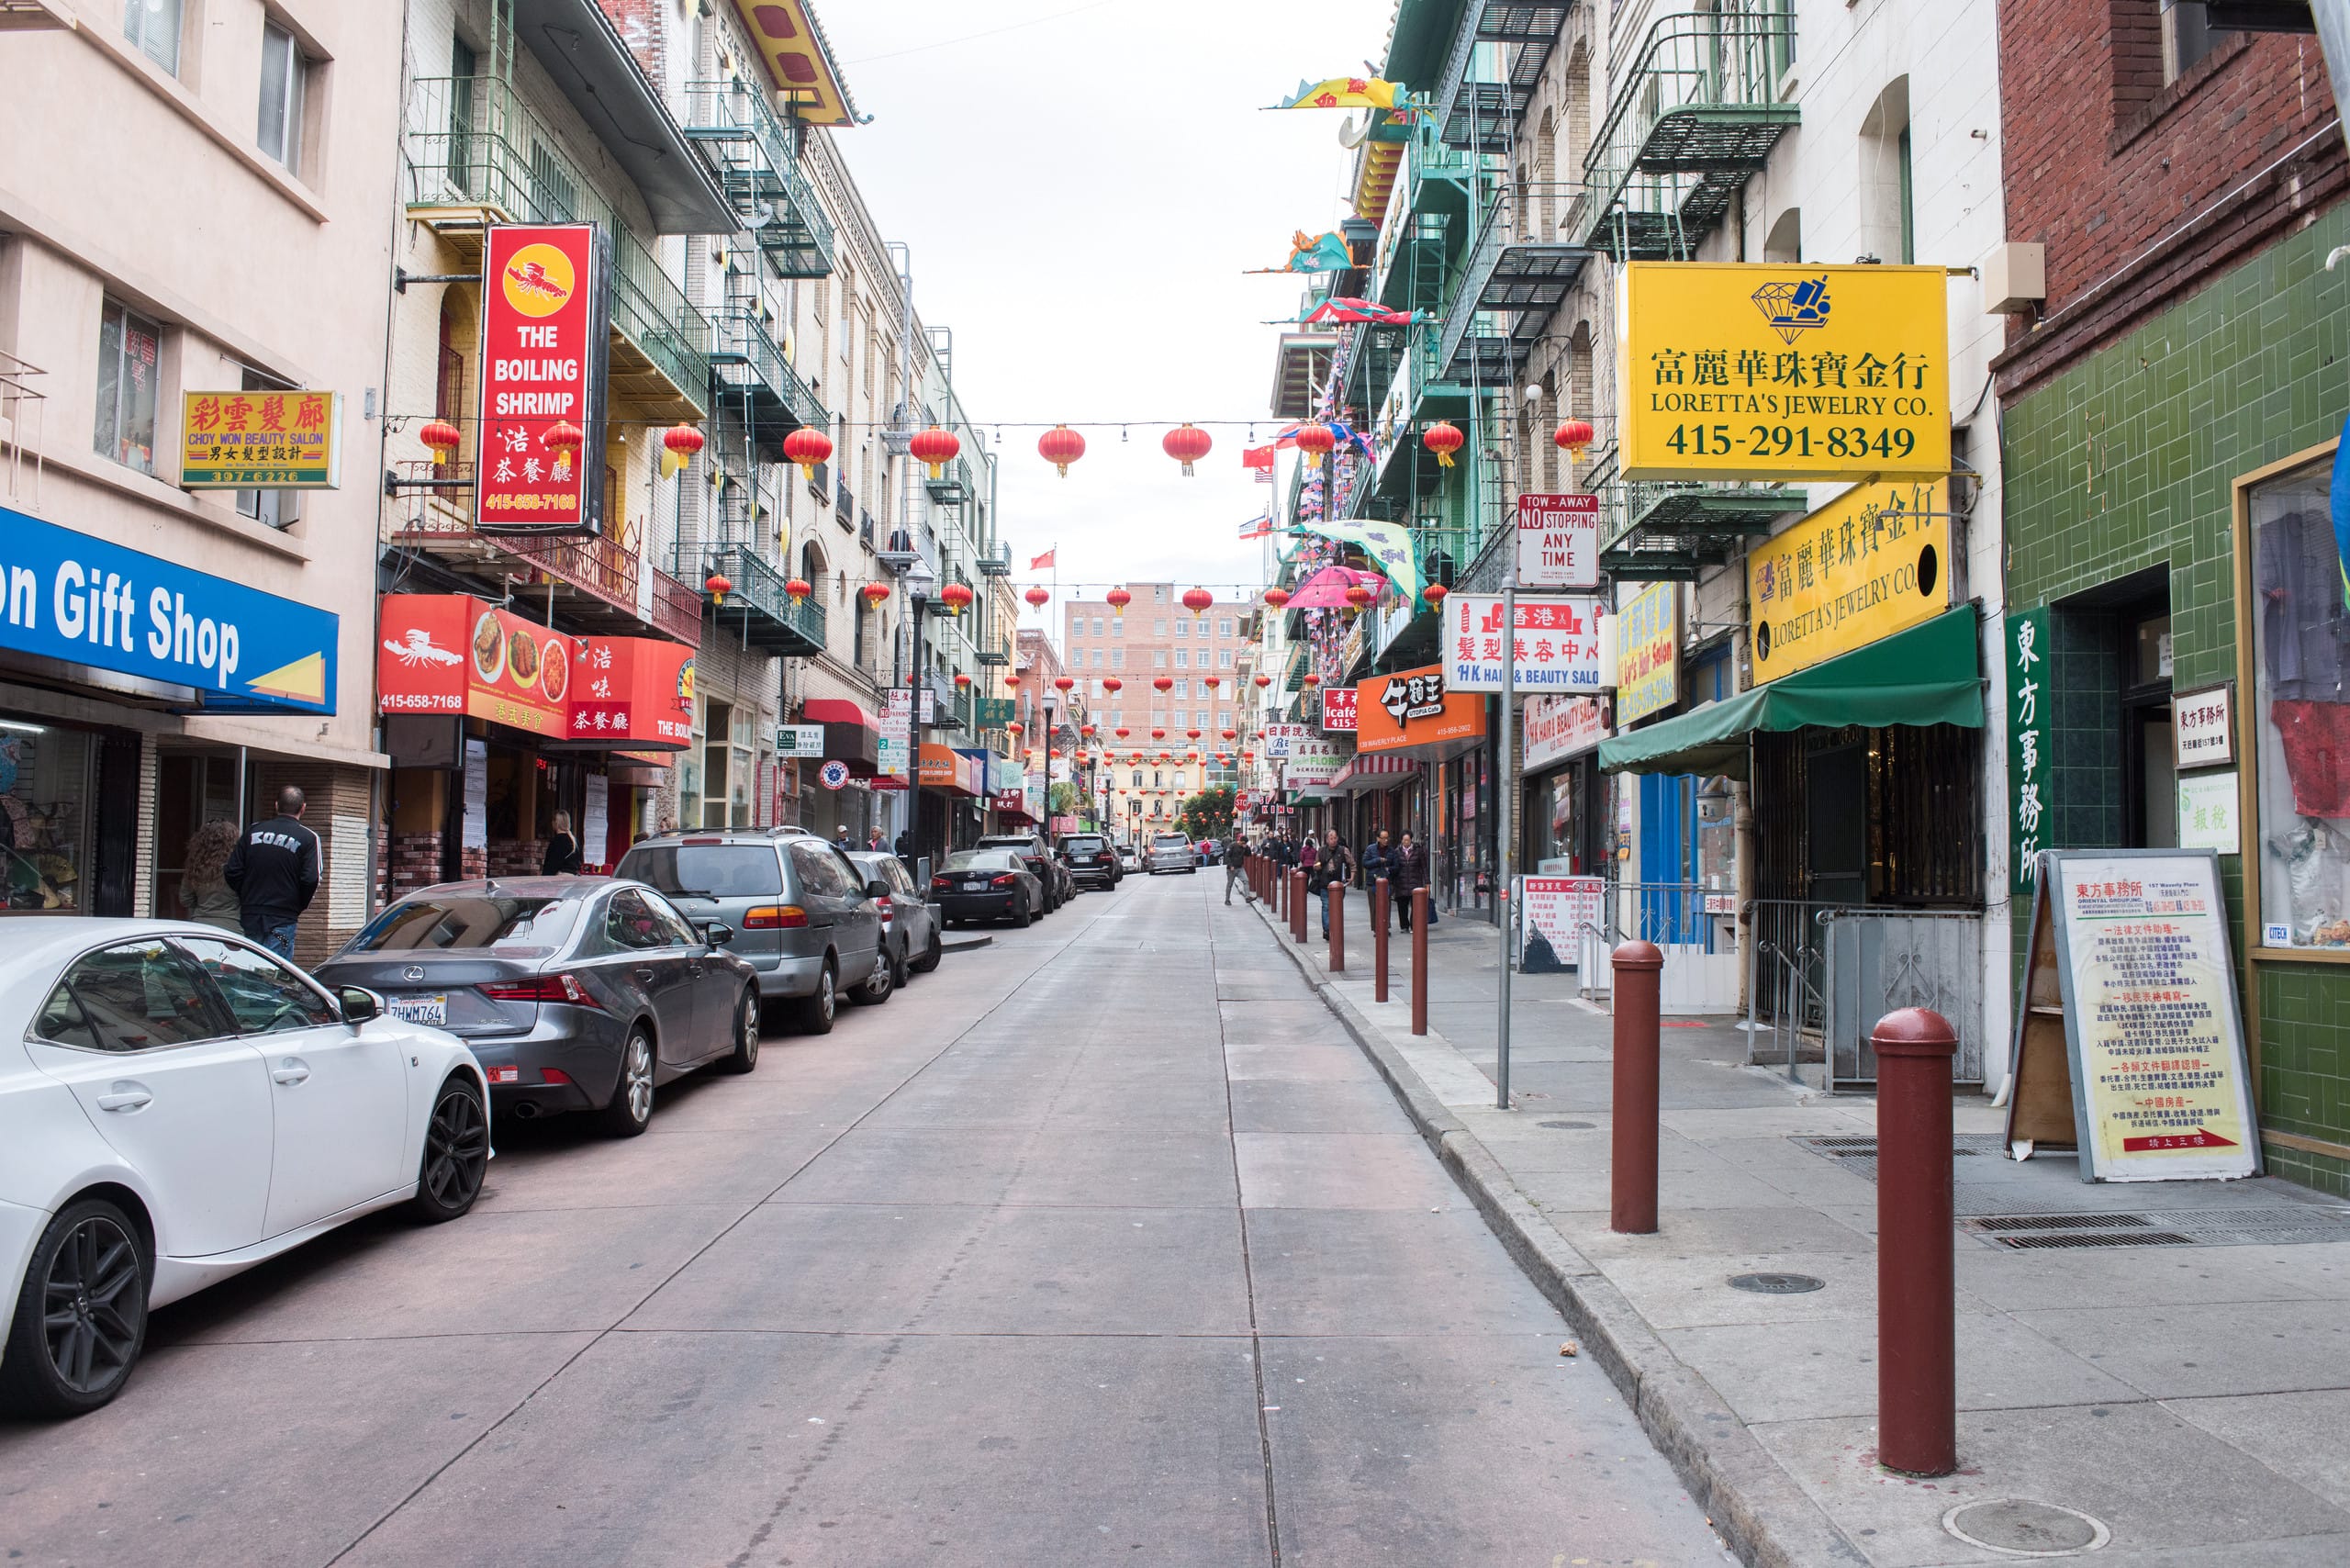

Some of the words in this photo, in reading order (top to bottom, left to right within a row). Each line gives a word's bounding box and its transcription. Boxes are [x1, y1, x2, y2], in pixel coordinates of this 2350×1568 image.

[517, 326, 558, 348] THE
[495, 359, 578, 382] BOILING
[1651, 348, 1930, 390] 富麗華珠寶金行
[191, 394, 325, 432] 彩雲髮廊
[496, 393, 575, 415] SHRIMP
[1651, 393, 1778, 414] LORETTA'S
[1782, 396, 1887, 420] JEWELRY
[1894, 398, 1933, 416] CO.
[188, 433, 216, 445] CHOY
[220, 433, 241, 445] WON
[245, 433, 285, 445] BEAUTY
[289, 433, 323, 445] SALON
[1665, 424, 1915, 458] 415-291-8349
[209, 446, 302, 461] 男女髮型設計
[211, 472, 298, 482] 397-6226
[492, 457, 573, 484] 茶餐廳
[486, 494, 576, 510] 415-658-7168
[1526, 497, 1549, 508] TOW
[1559, 497, 1591, 508] AWAY
[1521, 508, 1541, 529] NO
[1546, 513, 1595, 530] STOPPING
[1543, 533, 1572, 548] ANY
[1777, 481, 1935, 602] 富麗華珠寶金行
[1541, 552, 1575, 566] TIME
[1774, 602, 1831, 648] LORETTA'S
[1833, 573, 1890, 631] JEWELRY
[1894, 563, 1918, 596] CO.
[0, 564, 37, 630] n
[53, 560, 135, 653] Gift
[147, 585, 240, 689] Shop
[1514, 607, 1556, 626] 香港
[1652, 636, 1672, 670] Salon
[591, 644, 612, 699] 浩味
[1458, 664, 1481, 682] HK
[1484, 668, 1503, 682] HAI
[1515, 670, 1521, 683] &
[1526, 669, 1569, 684] BEAUTY
[1572, 669, 1599, 685] SALO
[381, 694, 462, 709] 415-658-7168
[496, 703, 543, 730] 港式美食
[572, 711, 629, 731] 茶餐廳
[880, 709, 890, 718] NO
[1409, 708, 1427, 716] UTOPIA
[1557, 704, 1579, 735] BEAUTY
[2180, 703, 2225, 731] 東方事務所
[657, 720, 674, 735] THE
[778, 732, 795, 740] EVA
[1368, 737, 1391, 747] WAVERLY
[1391, 734, 1407, 743] PLACE
[1269, 747, 1289, 756] Laun
[1310, 757, 1348, 766] FLORIST
[2017, 620, 2043, 884] 東方事務所
[2076, 881, 2143, 898] 東方事務所
[391, 1005, 442, 1021] 7HWM764
